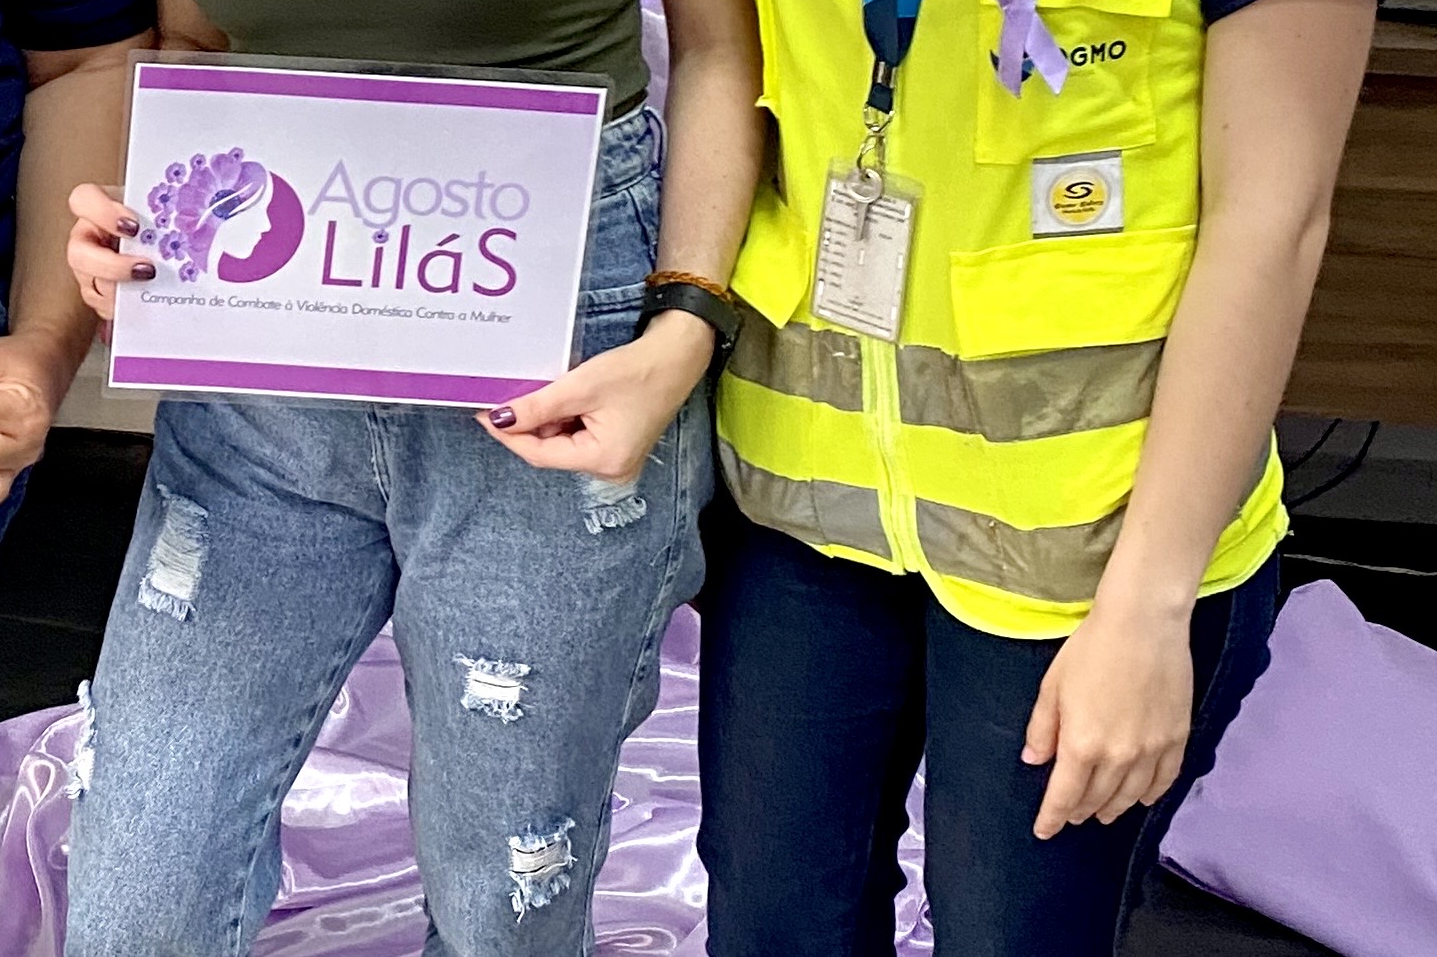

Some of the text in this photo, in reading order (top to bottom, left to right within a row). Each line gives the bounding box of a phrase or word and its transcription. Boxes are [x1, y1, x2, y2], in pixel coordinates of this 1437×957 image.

[307, 159, 530, 229] Agosto
[320, 220, 518, 297] LiláS
[140, 291, 206, 306] Campanha
[209, 295, 225, 307] de
[228, 295, 282, 310] Combate
[297, 299, 348, 314] Violência
[351, 303, 413, 318] Doméstica
[416, 307, 455, 321] Contra
[458, 312, 467, 321] a
[469, 310, 512, 323] Mulher
